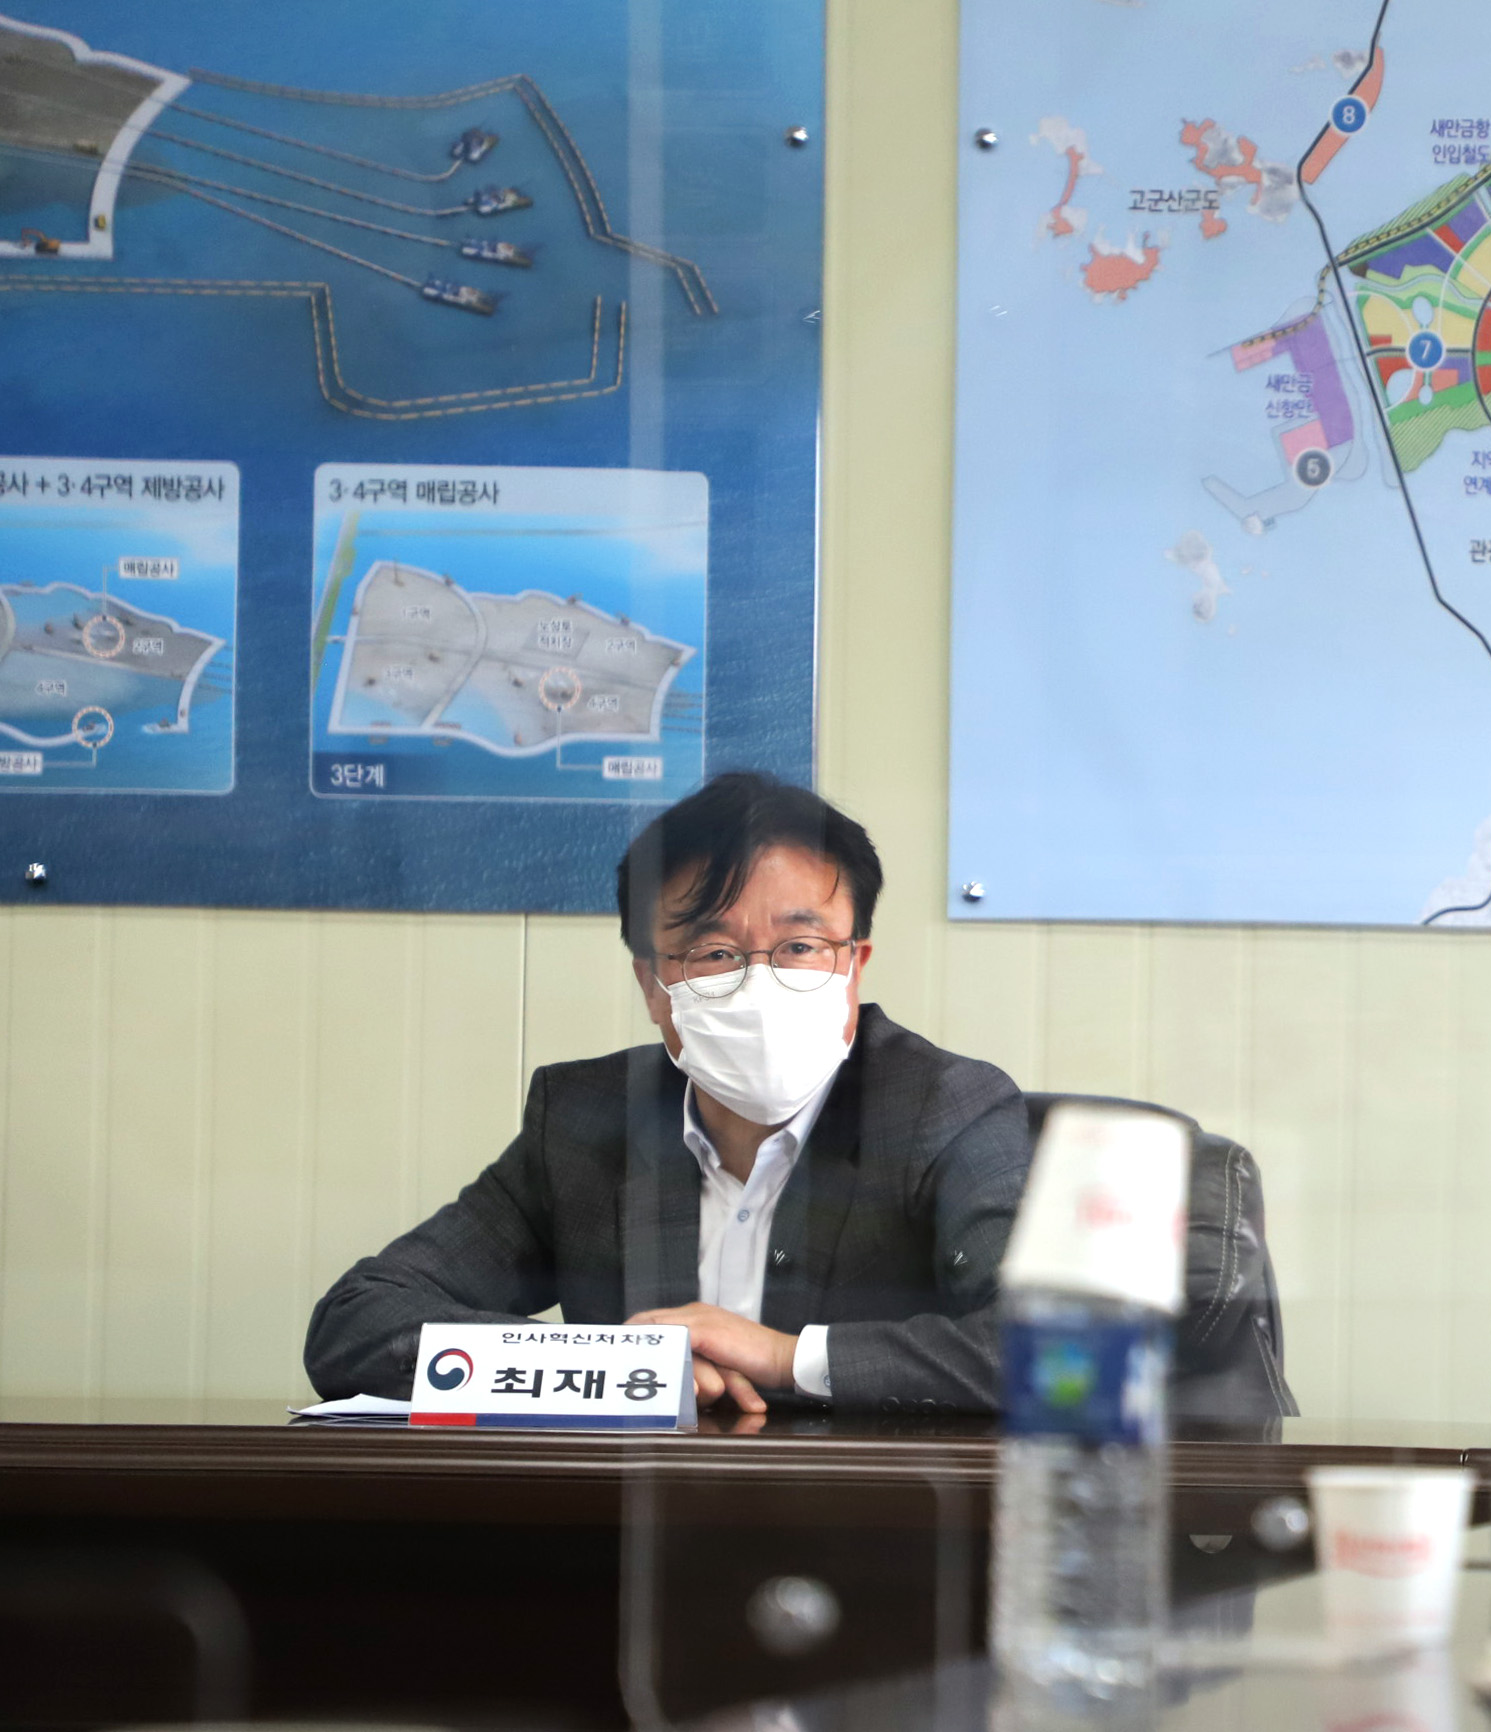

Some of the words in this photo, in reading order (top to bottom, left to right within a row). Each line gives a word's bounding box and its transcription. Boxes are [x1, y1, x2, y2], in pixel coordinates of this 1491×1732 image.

[1341, 105, 1355, 125] 8
[1430, 118, 1490, 140] 새만금항
[1432, 144, 1490, 165] 인입철도
[1128, 189, 1220, 212] 고군산군도
[1265, 374, 1312, 393] 새만금
[0, 470, 28, 497] 사
[36, 476, 49, 492] +
[141, 475, 225, 501] 제방공사
[416, 479, 499, 505] 매립공사
[123, 561, 174, 577] 매립공사
[330, 764, 385, 787] 3단계
[607, 760, 658, 777] 매립공사
[491, 1367, 667, 1401] 최재용
